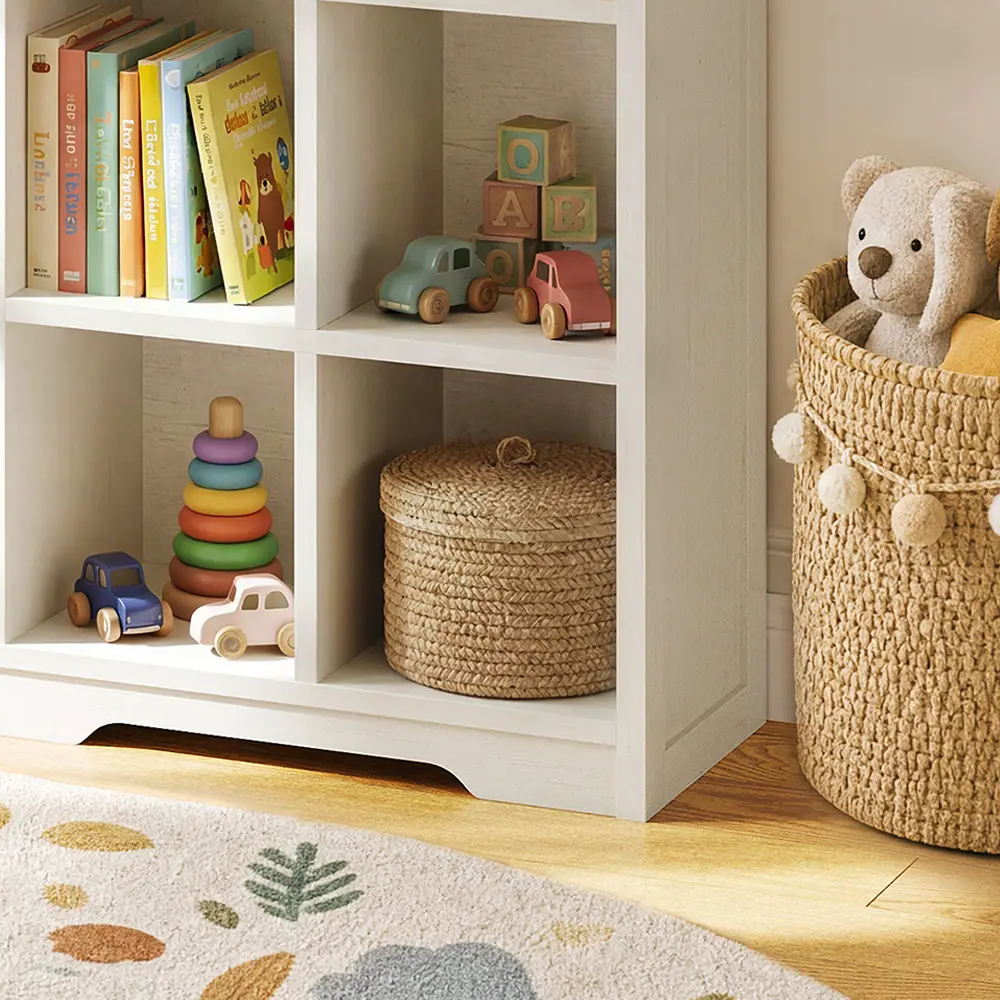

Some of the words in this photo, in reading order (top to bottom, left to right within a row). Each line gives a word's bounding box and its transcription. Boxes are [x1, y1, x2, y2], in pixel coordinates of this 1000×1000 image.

[506, 137, 539, 175] O
[492, 190, 531, 228] A
[551, 194, 588, 232] B
